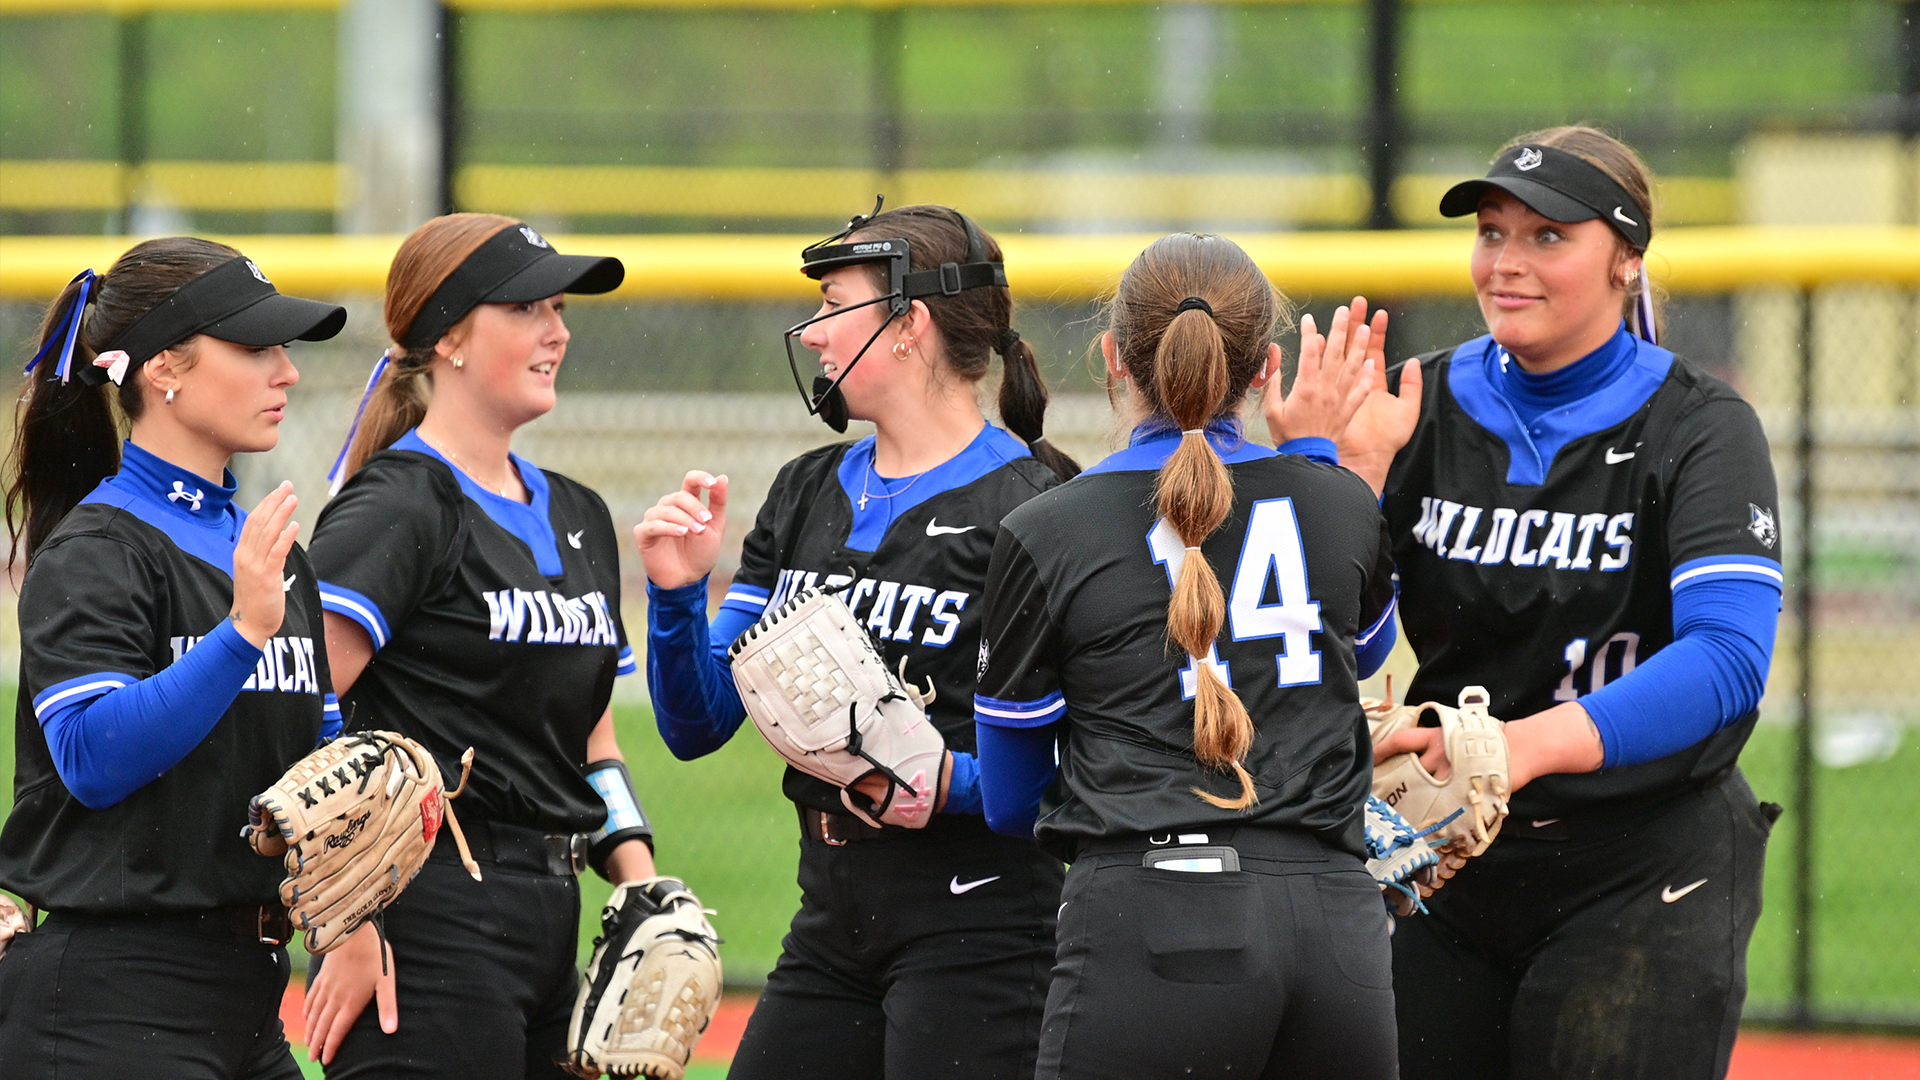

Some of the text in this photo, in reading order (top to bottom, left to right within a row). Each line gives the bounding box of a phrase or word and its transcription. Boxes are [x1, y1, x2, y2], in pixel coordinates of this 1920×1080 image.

[1412, 496, 1635, 572] WILDCATS
[1145, 496, 1324, 702] 14
[1553, 631, 1641, 702] 10
[323, 809, 372, 855] Rawlings
[356, 899, 373, 916] GOLD
